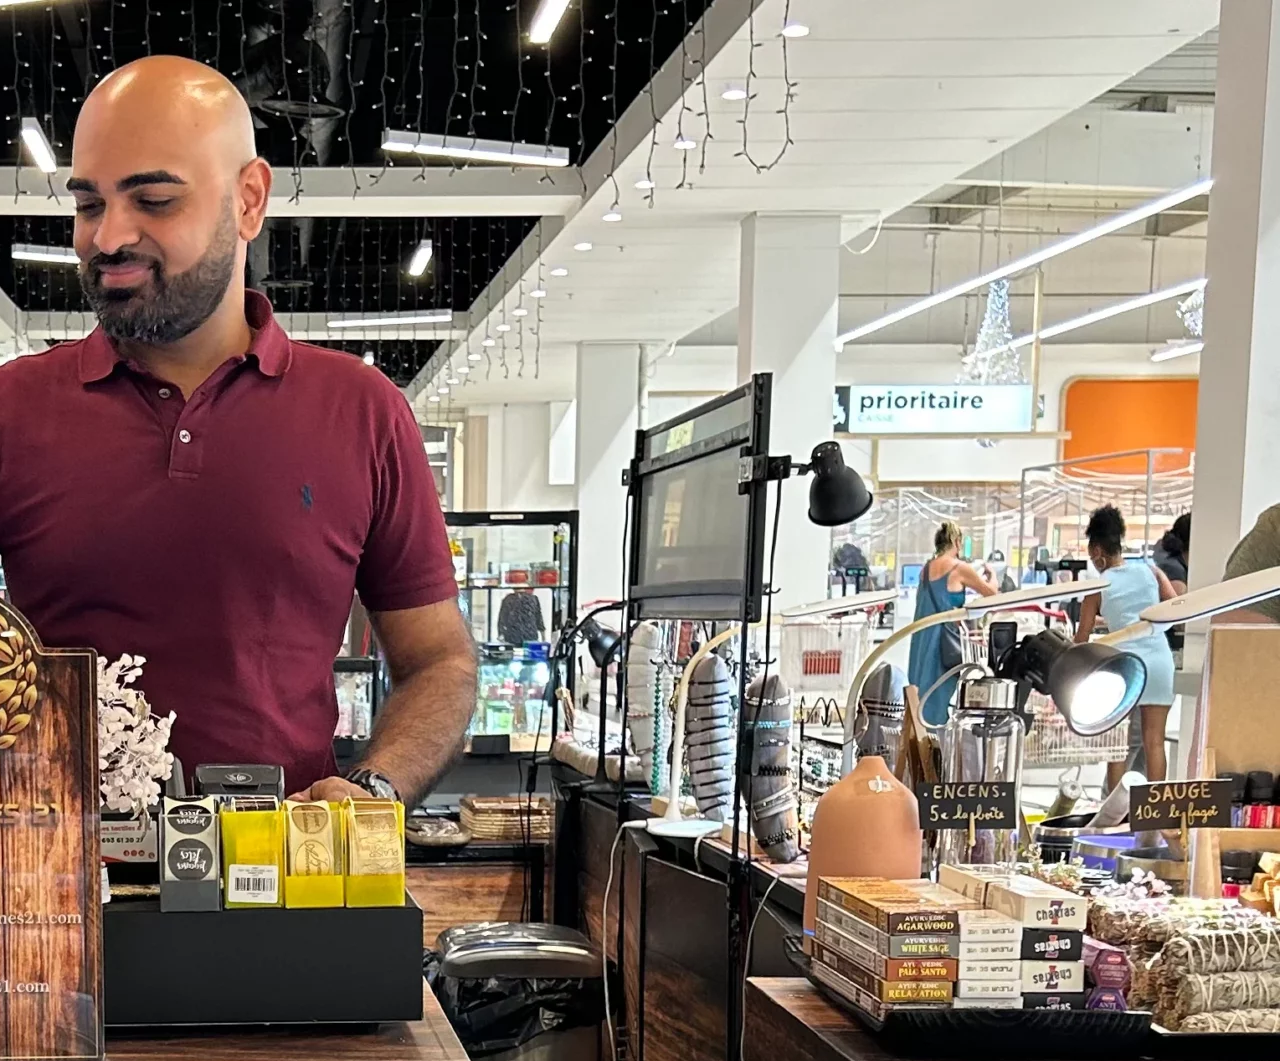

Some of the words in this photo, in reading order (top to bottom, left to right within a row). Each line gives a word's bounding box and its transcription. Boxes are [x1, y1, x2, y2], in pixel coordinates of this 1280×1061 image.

[860, 391, 984, 412] prioritaire
[1148, 782, 1212, 803] SAUGE
[32, 802, 62, 824] 21
[1168, 804, 1181, 818] le
[1187, 802, 1218, 825] fagot
[896, 922, 954, 932] AGARWOOD
[901, 944, 927, 954] WHITE
[928, 944, 950, 954] SAGE
[920, 968, 947, 976] SANTO
